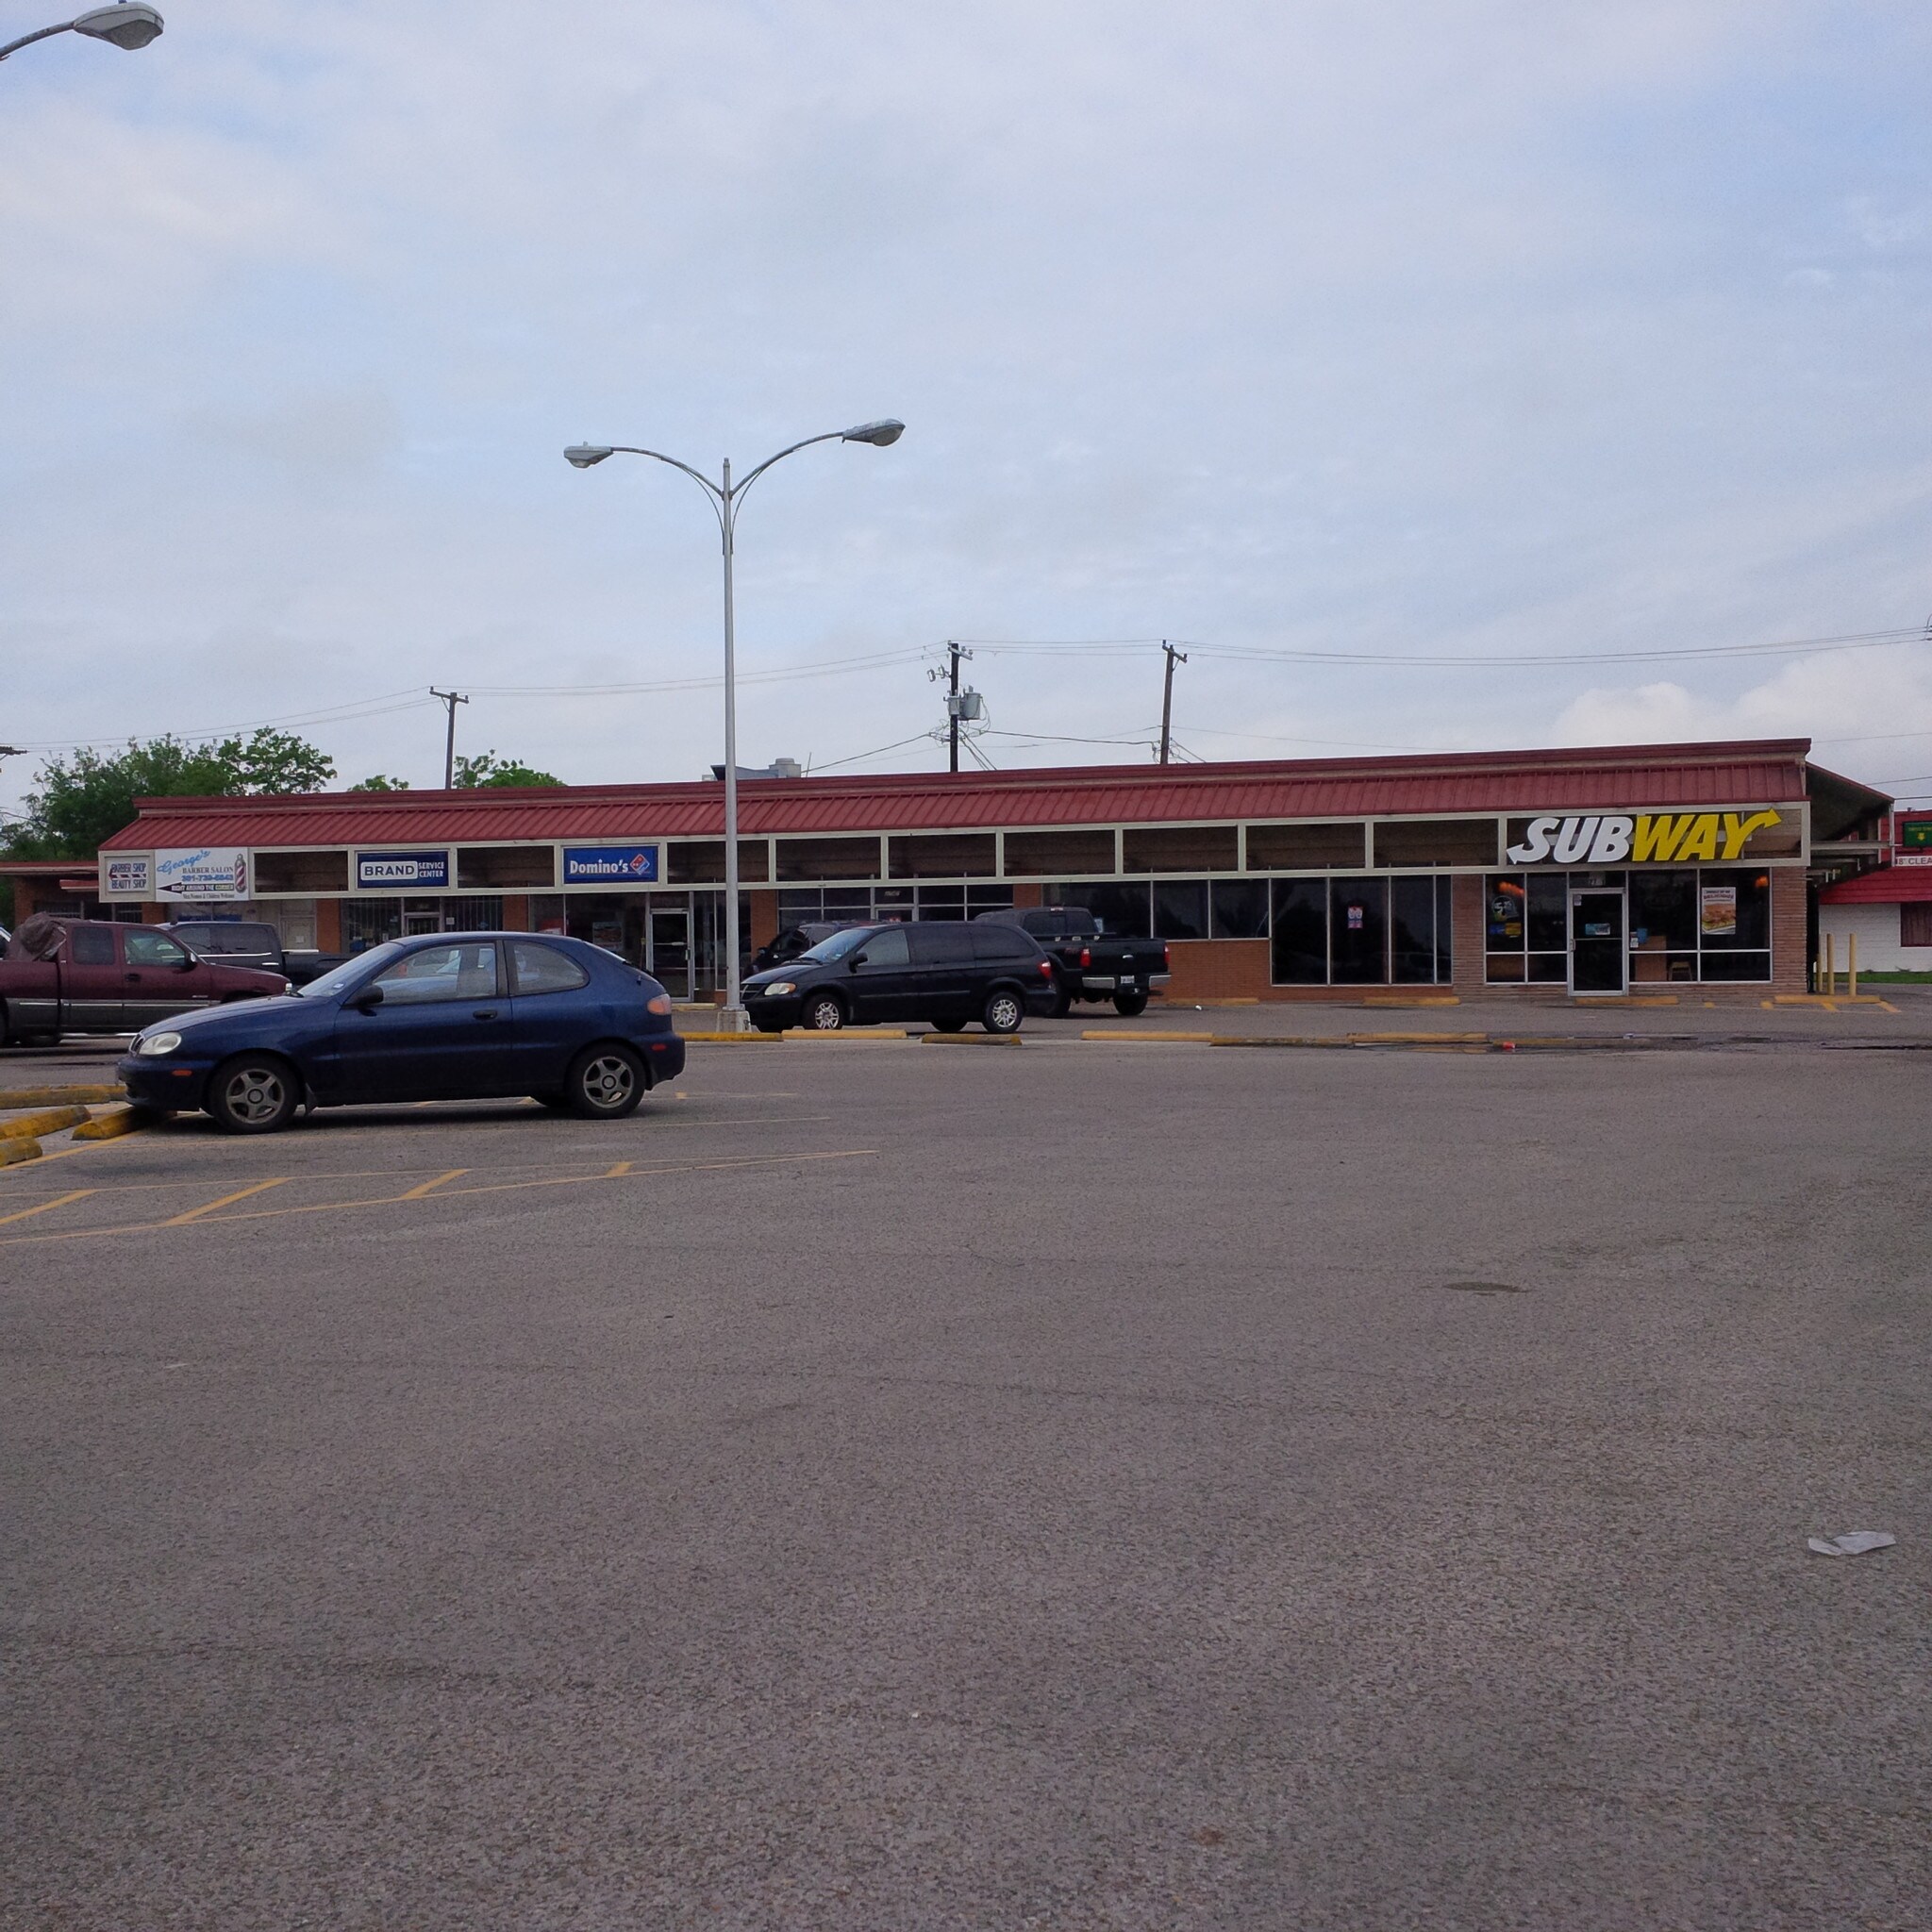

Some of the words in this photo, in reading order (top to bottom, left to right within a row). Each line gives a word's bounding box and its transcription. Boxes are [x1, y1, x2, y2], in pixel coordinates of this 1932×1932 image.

[1507, 808, 1781, 864] SUBWAY
[111, 863, 132, 873] BARBER
[133, 862, 147, 873] SHOP
[157, 849, 210, 875] George's
[418, 861, 445, 870] SERVICE
[570, 858, 629, 874] Domino's
[364, 865, 415, 876] BRAND
[419, 870, 444, 878] CENTER
[111, 879, 131, 890] BEAUTY
[133, 878, 147, 889] SHOP
